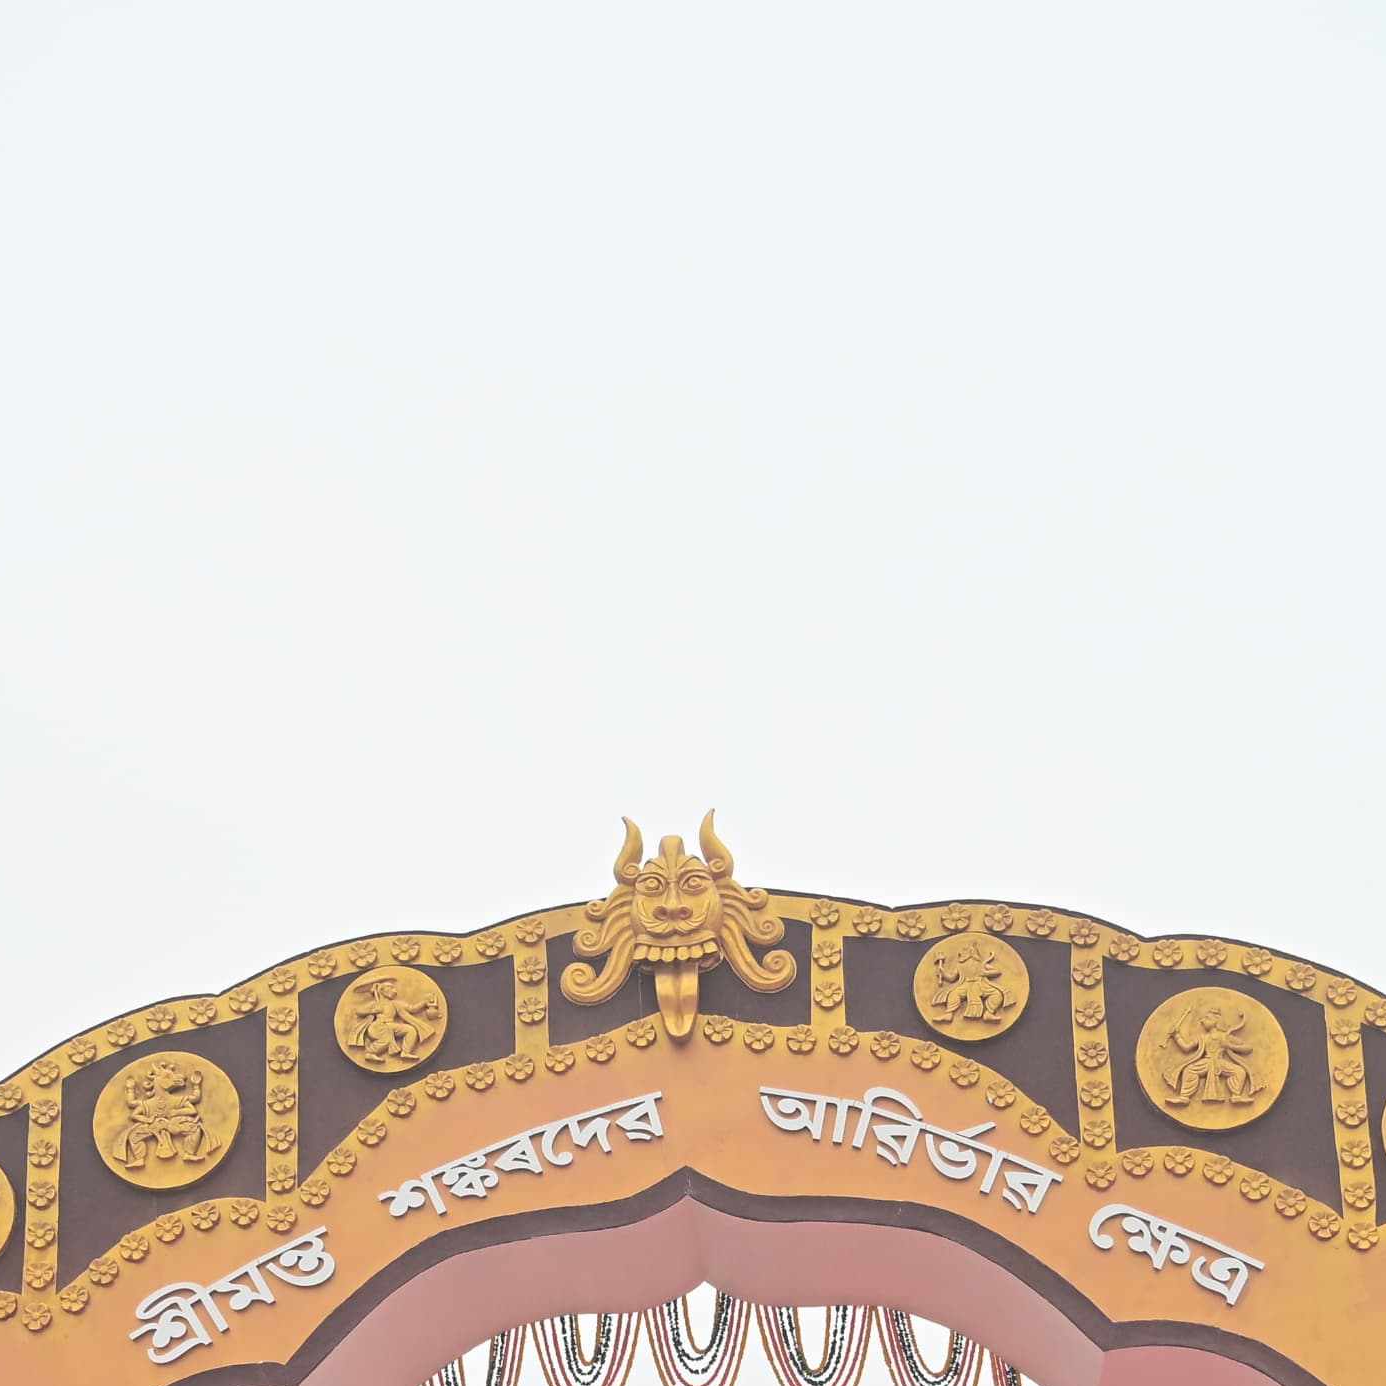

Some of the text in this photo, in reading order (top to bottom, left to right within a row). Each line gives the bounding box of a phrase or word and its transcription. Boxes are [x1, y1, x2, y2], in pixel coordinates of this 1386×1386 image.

[128, 1225, 335, 1364] শ্ৰীমন্ত
[377, 1091, 664, 1217] শঙ্কৰদেৱ
[1089, 1203, 1266, 1307] ক্ষেত্ৰ
